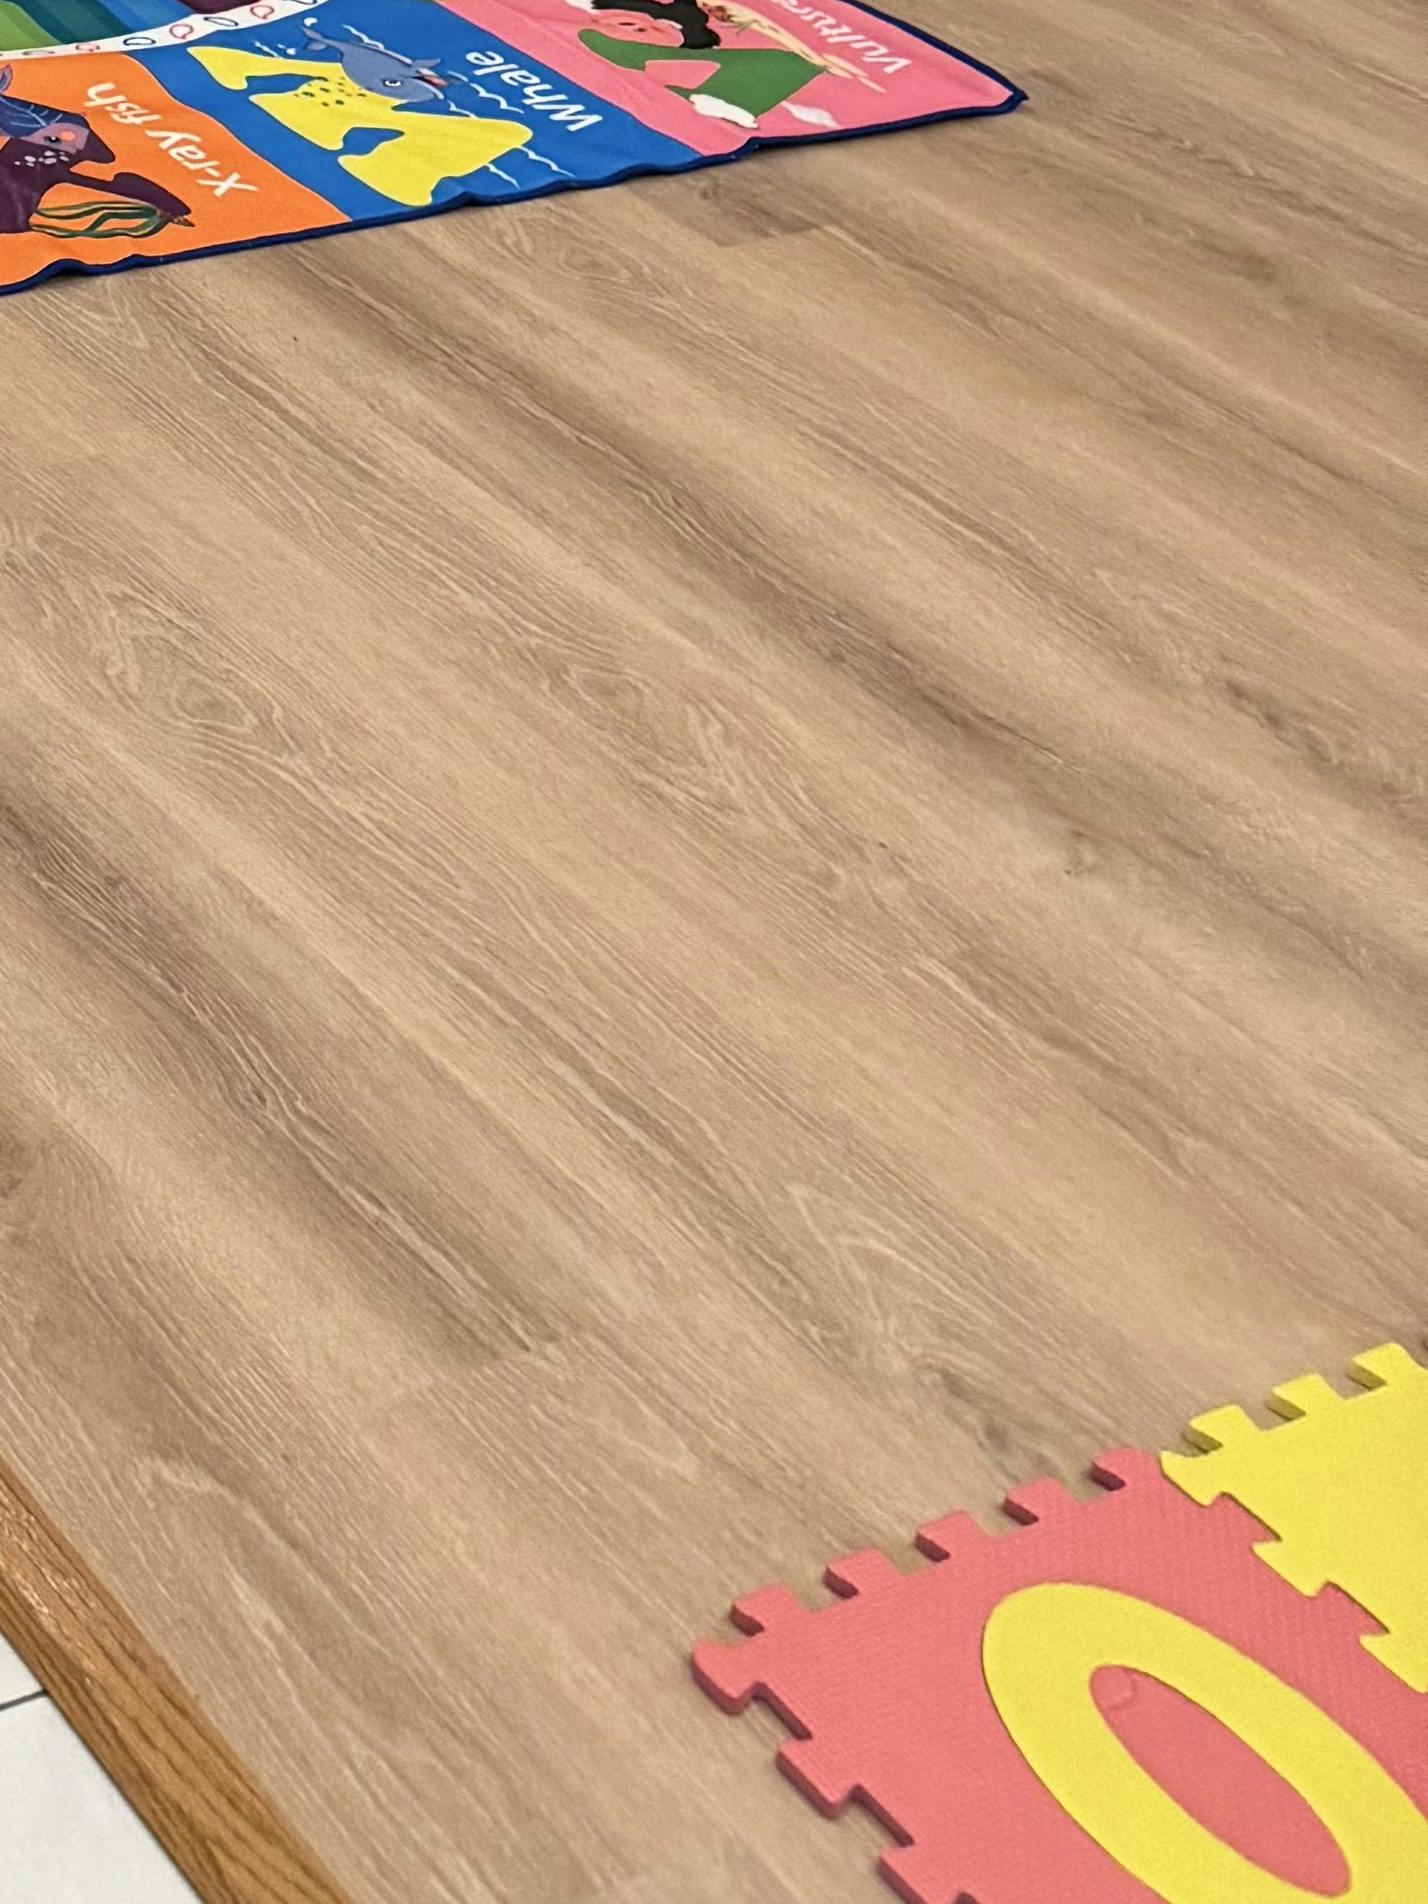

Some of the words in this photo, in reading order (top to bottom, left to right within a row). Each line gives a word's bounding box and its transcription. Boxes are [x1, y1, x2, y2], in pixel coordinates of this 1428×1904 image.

[84, 82, 160, 124] fish
[465, 51, 602, 131] Whale
[578, 27, 822, 125] V
[145, 130, 256, 196] X-ray
[187, 45, 533, 207] W
